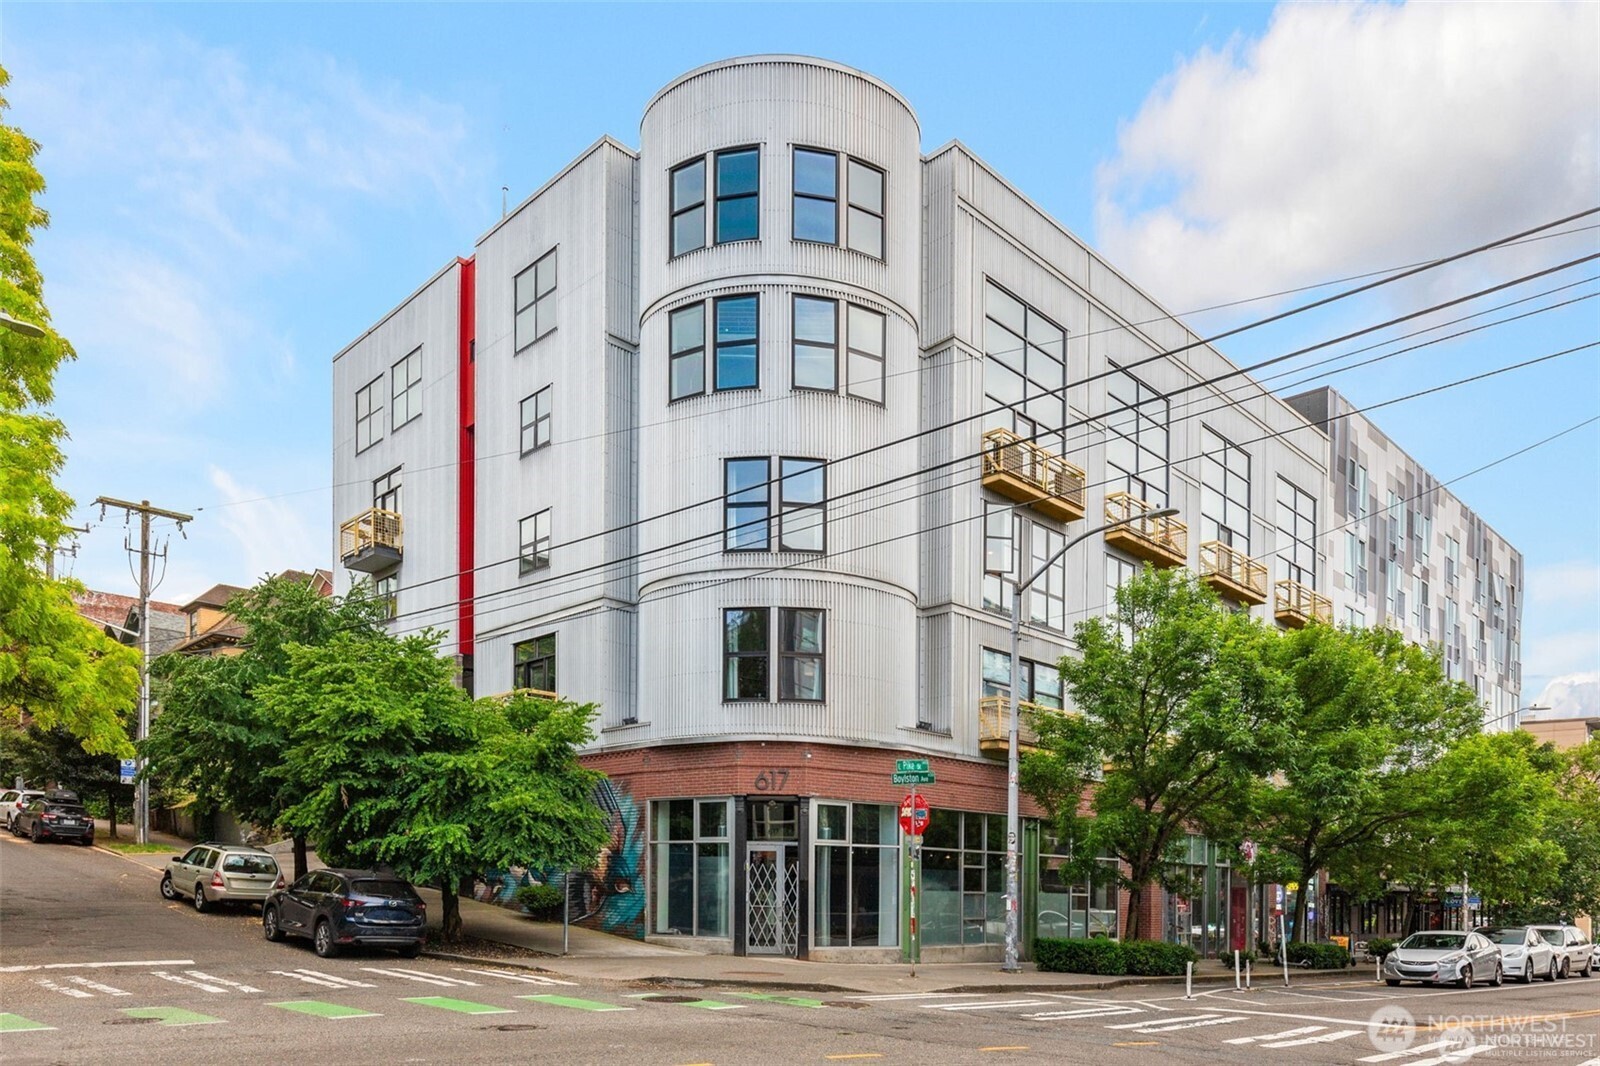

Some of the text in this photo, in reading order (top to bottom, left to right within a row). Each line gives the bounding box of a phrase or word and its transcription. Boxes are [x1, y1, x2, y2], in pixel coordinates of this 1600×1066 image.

[903, 761, 915, 770] Pike
[755, 769, 790, 791] 617
[893, 774, 919, 783] Boylston
